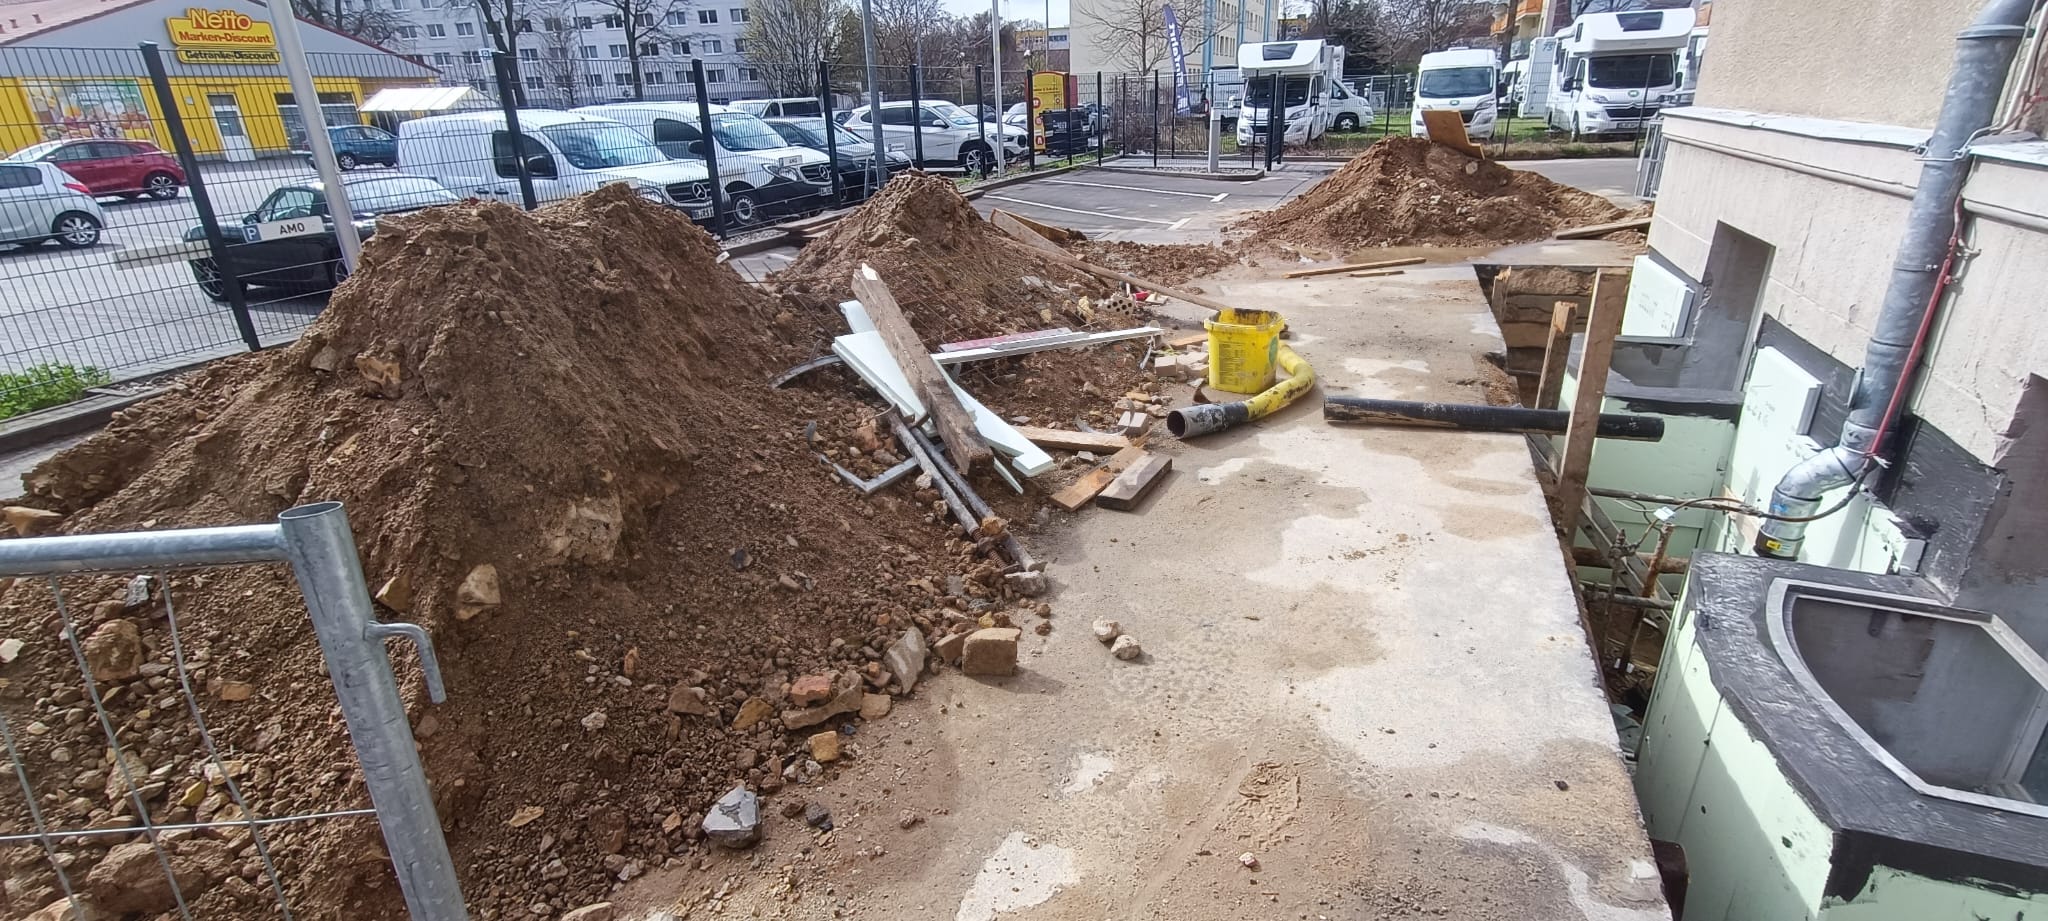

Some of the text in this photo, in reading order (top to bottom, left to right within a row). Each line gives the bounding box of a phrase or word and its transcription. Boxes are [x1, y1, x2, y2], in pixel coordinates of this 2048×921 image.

[190, 8, 252, 31] Netto
[179, 31, 272, 43] Marken-Discount
[280, 222, 305, 235] AMO
